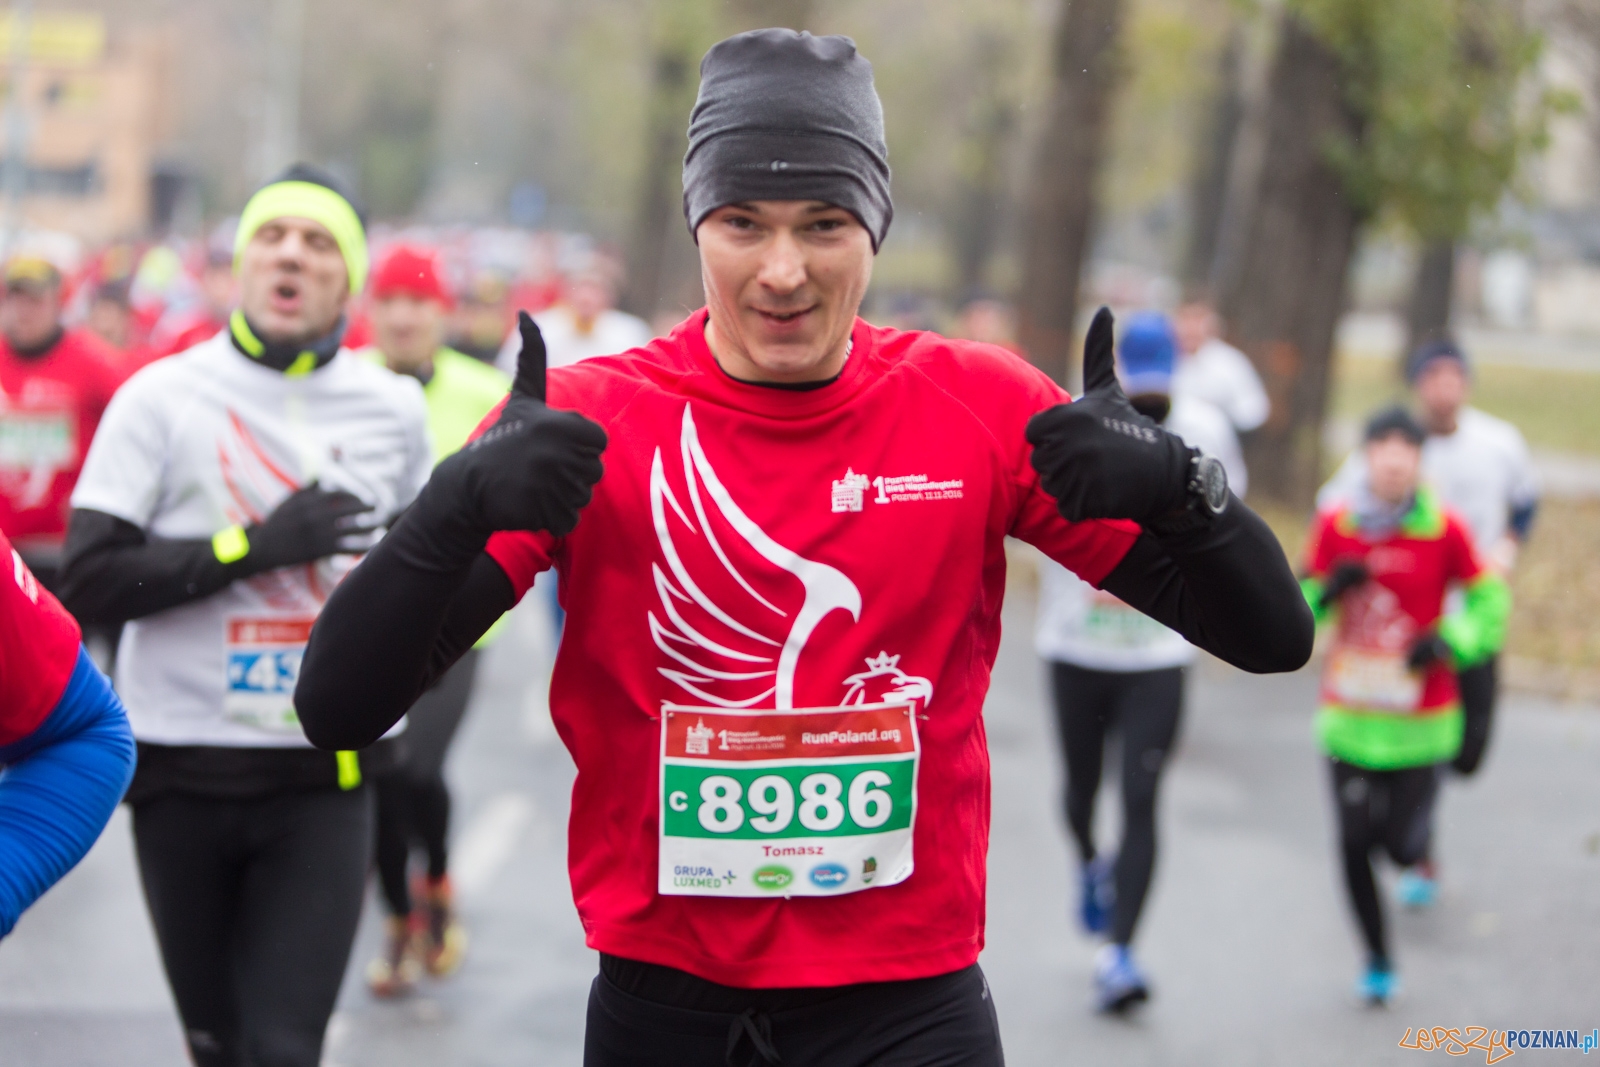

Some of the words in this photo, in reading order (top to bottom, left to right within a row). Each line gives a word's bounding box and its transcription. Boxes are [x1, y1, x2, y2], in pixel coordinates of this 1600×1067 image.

[872, 476, 891, 504] 1
[885, 483, 905, 493] Bieg
[718, 729, 731, 751] 1
[801, 728, 902, 745] RunPoland.org
[697, 769, 893, 834] 8986
[762, 845, 824, 857] Tomasz
[674, 865, 714, 877] GRUPA
[674, 877, 722, 888] LUXMED
